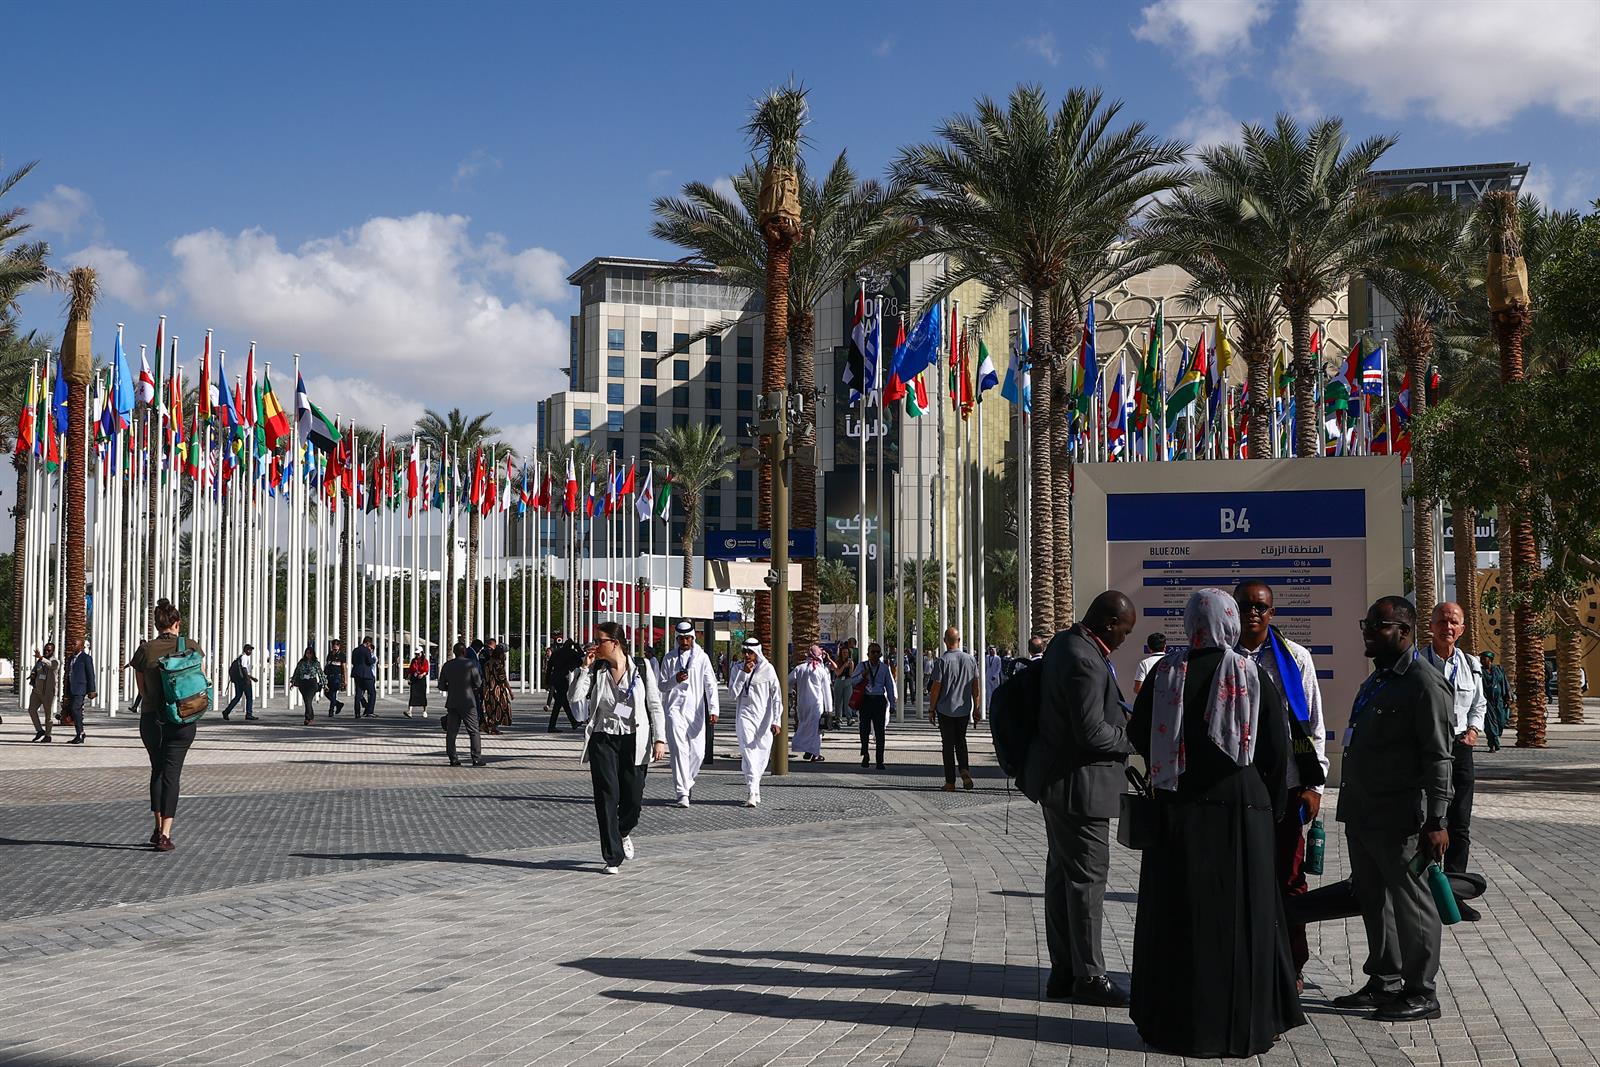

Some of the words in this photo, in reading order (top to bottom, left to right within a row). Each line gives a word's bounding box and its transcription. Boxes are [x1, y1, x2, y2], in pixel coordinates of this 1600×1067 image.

[1220, 507, 1251, 533] B4
[1149, 547, 1169, 556] BLUE
[1170, 546, 1190, 556] ZONE
[1261, 545, 1287, 557] الزرقاء
[1288, 545, 1324, 554] المنطقة
